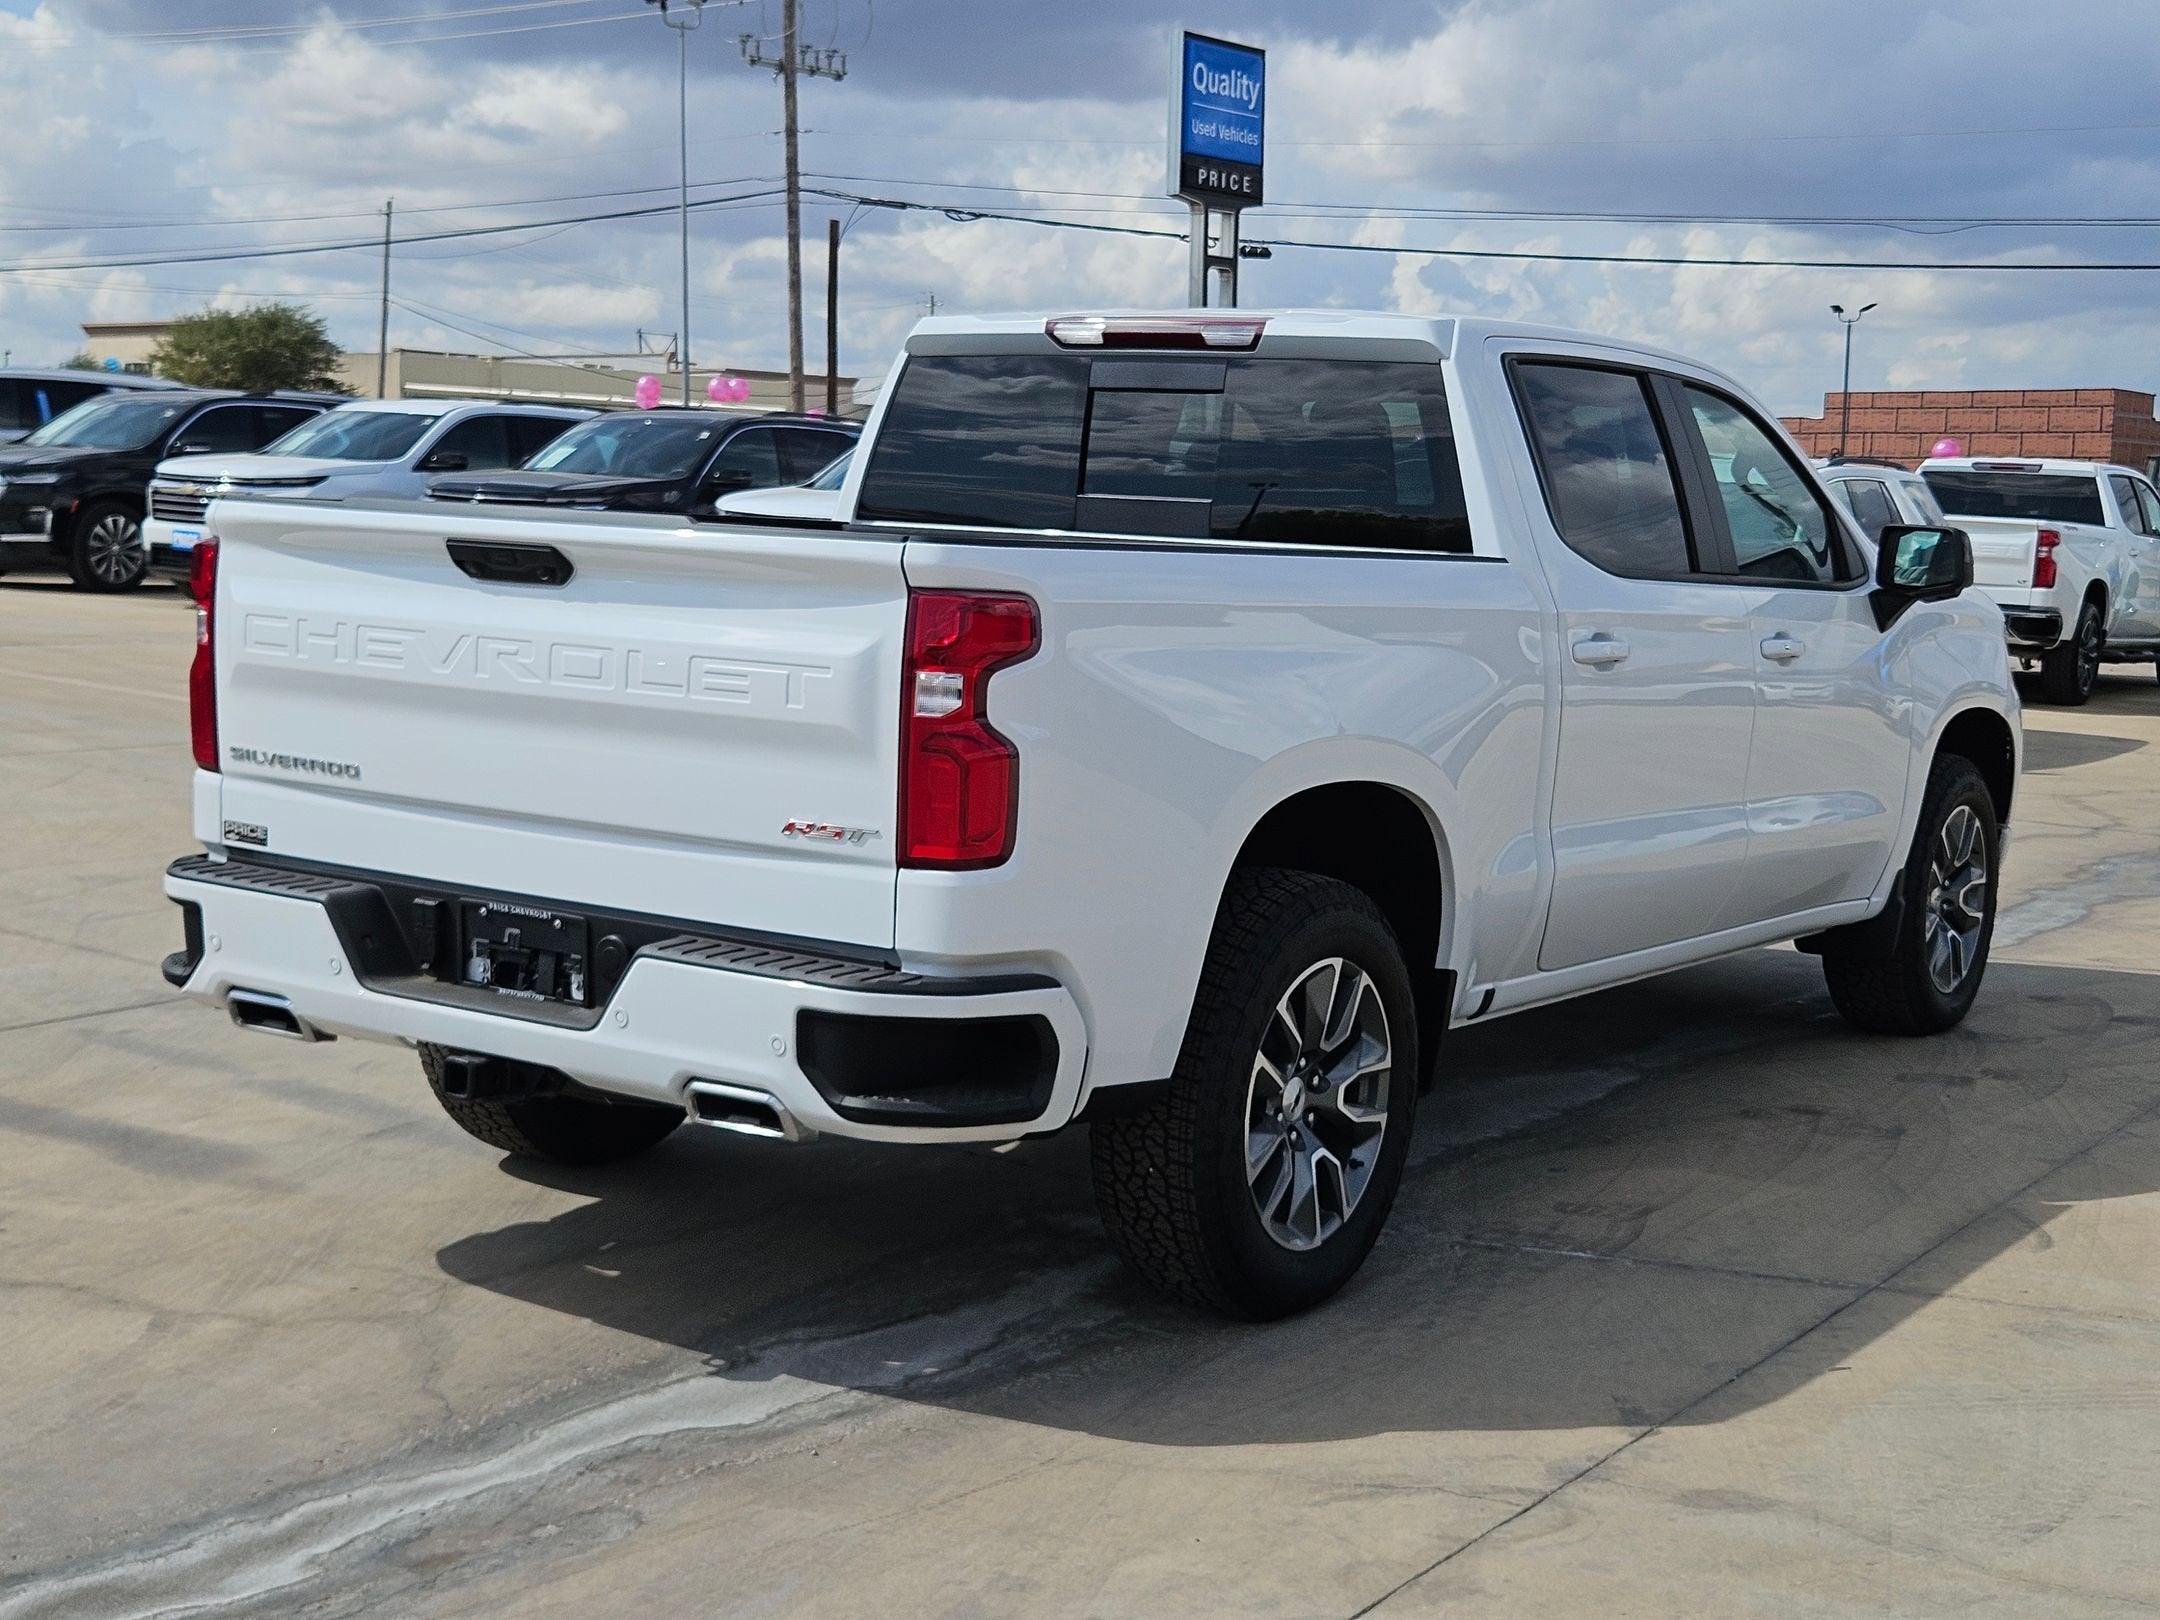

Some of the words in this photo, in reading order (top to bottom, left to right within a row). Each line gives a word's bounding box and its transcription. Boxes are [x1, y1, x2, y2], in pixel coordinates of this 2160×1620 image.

[1192, 62, 1260, 110] Quality
[1192, 119, 1216, 138] Used
[1218, 124, 1259, 146] Vehicles
[1198, 168, 1251, 193] PRICE
[244, 613, 834, 710] CHEVROLET
[229, 746, 361, 779] SILVERADO
[225, 822, 267, 840] PRICE
[781, 818, 879, 844] RST
[510, 904, 551, 919] CHEVROLET
